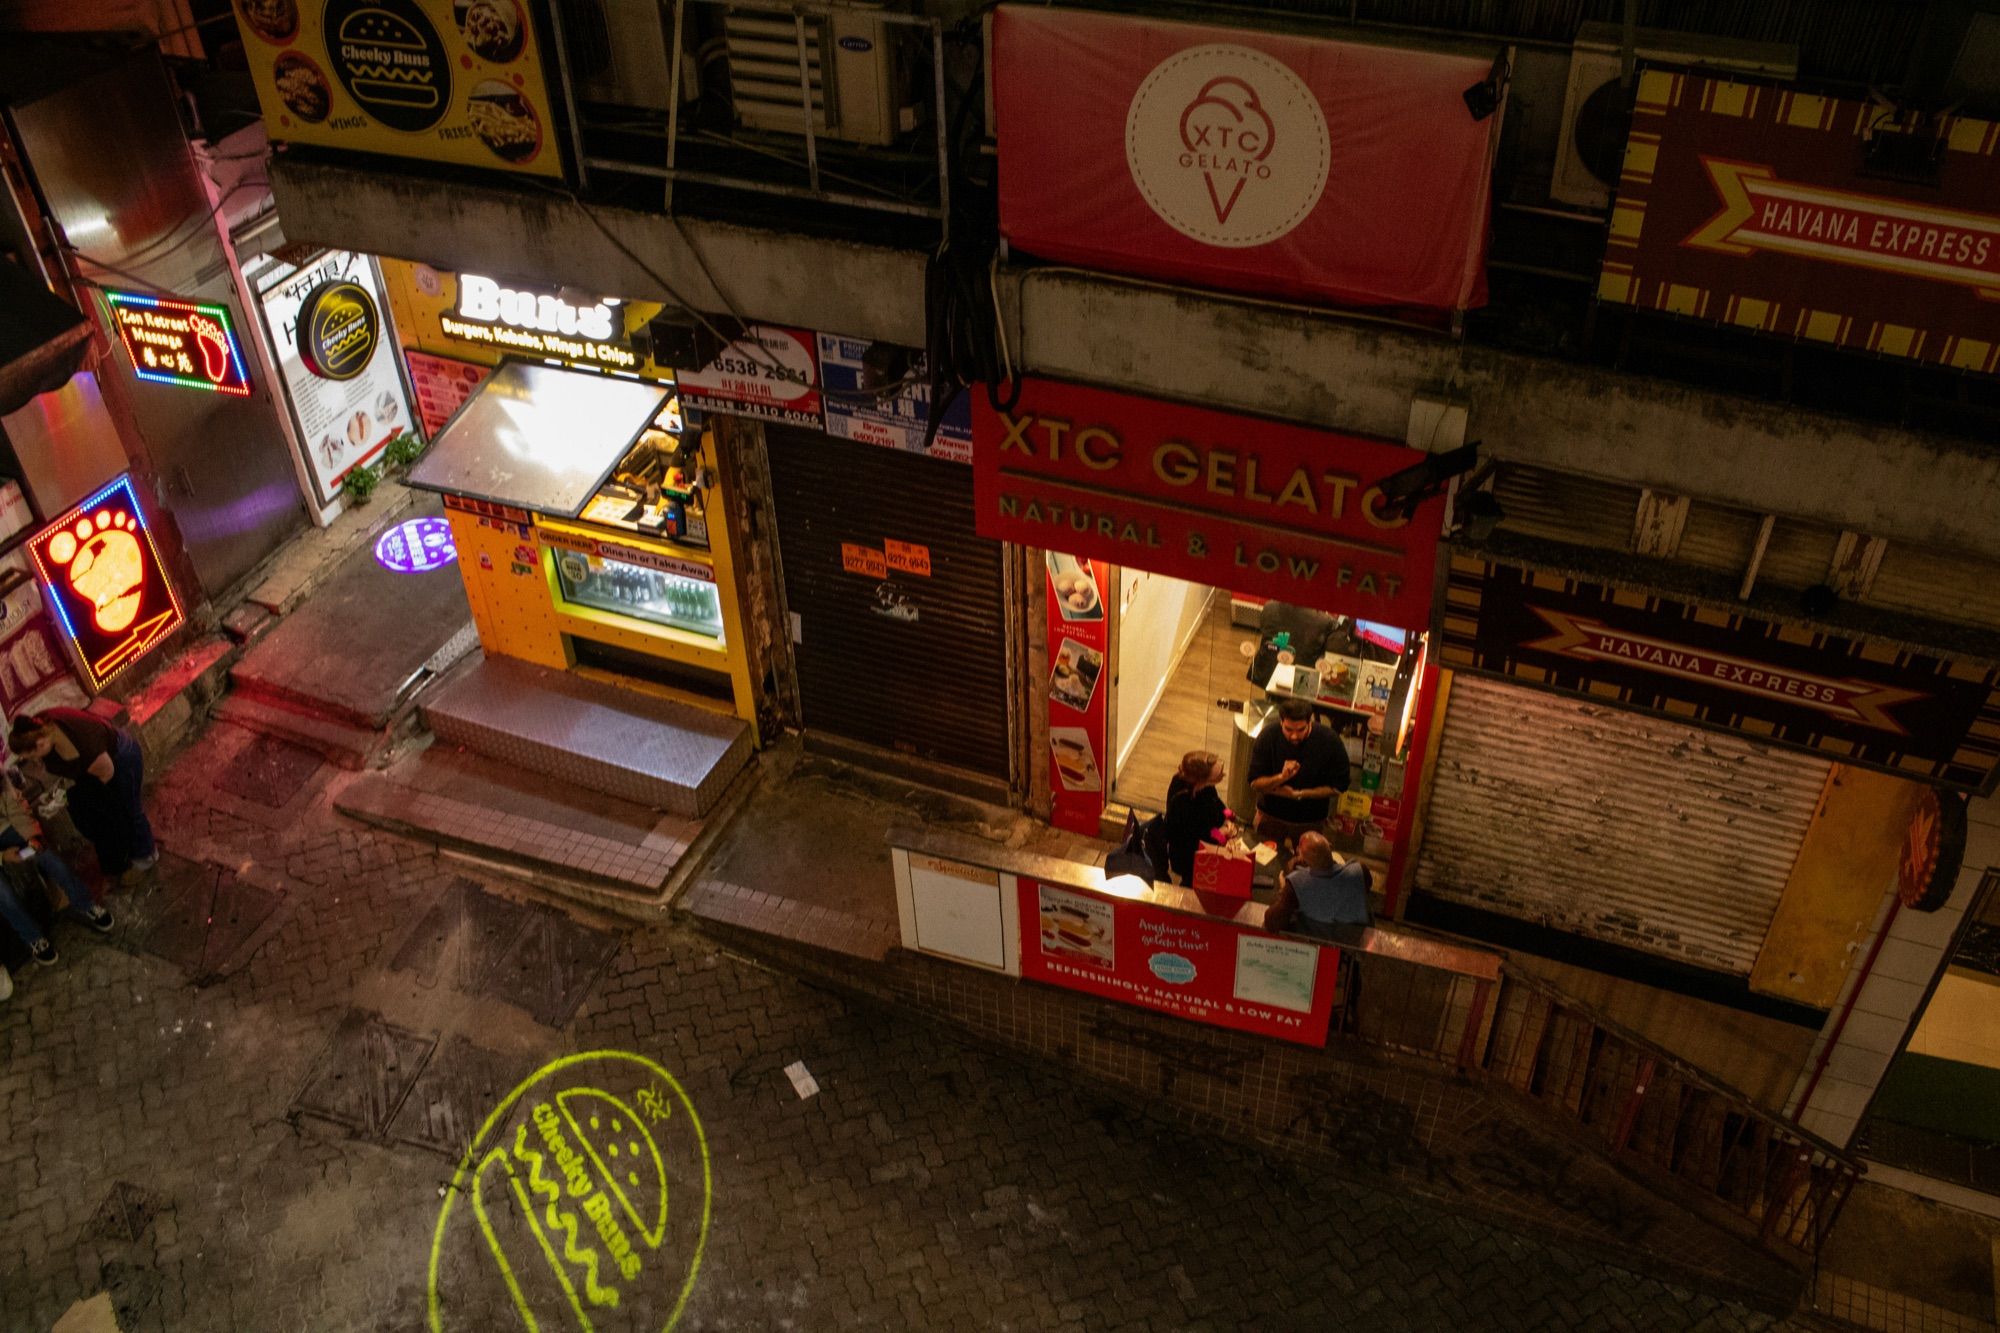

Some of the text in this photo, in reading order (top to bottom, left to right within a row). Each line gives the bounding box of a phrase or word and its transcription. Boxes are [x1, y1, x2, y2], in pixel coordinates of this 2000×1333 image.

[341, 44, 431, 68] Cheeky Buns
[327, 115, 369, 131] WINGS
[1193, 125, 1260, 153] XTC
[1179, 153, 1272, 180] GELATO
[1761, 201, 1991, 266] HAVANA EXPRESS
[119, 308, 190, 333] Zen Retreat
[459, 273, 613, 341] Buns
[131, 326, 184, 351] Massage
[321, 328, 348, 351] Cheeky
[346, 315, 366, 335] Buns
[441, 317, 635, 367] Burgers, Kebabs, Wings & Chips
[713, 356, 758, 378] 6538
[862, 420, 888, 435] Bryan
[999, 411, 1122, 471] XTC
[601, 544, 710, 580] Dine-In or Take-Away
[999, 495, 1401, 600] NATURAL & LOW FAT
[1600, 636, 1836, 702] HAVANA EXPRESS
[1138, 917, 1201, 940] Anytime is
[1046, 961, 1150, 994] REFRESHINGLY
[1154, 988, 1220, 1010] NATURAL
[1224, 1003, 1235, 1013] &
[1239, 1006, 1273, 1021] LOW
[1275, 1013, 1303, 1028] FAT
[532, 1102, 642, 1281] Cheeky Buns
